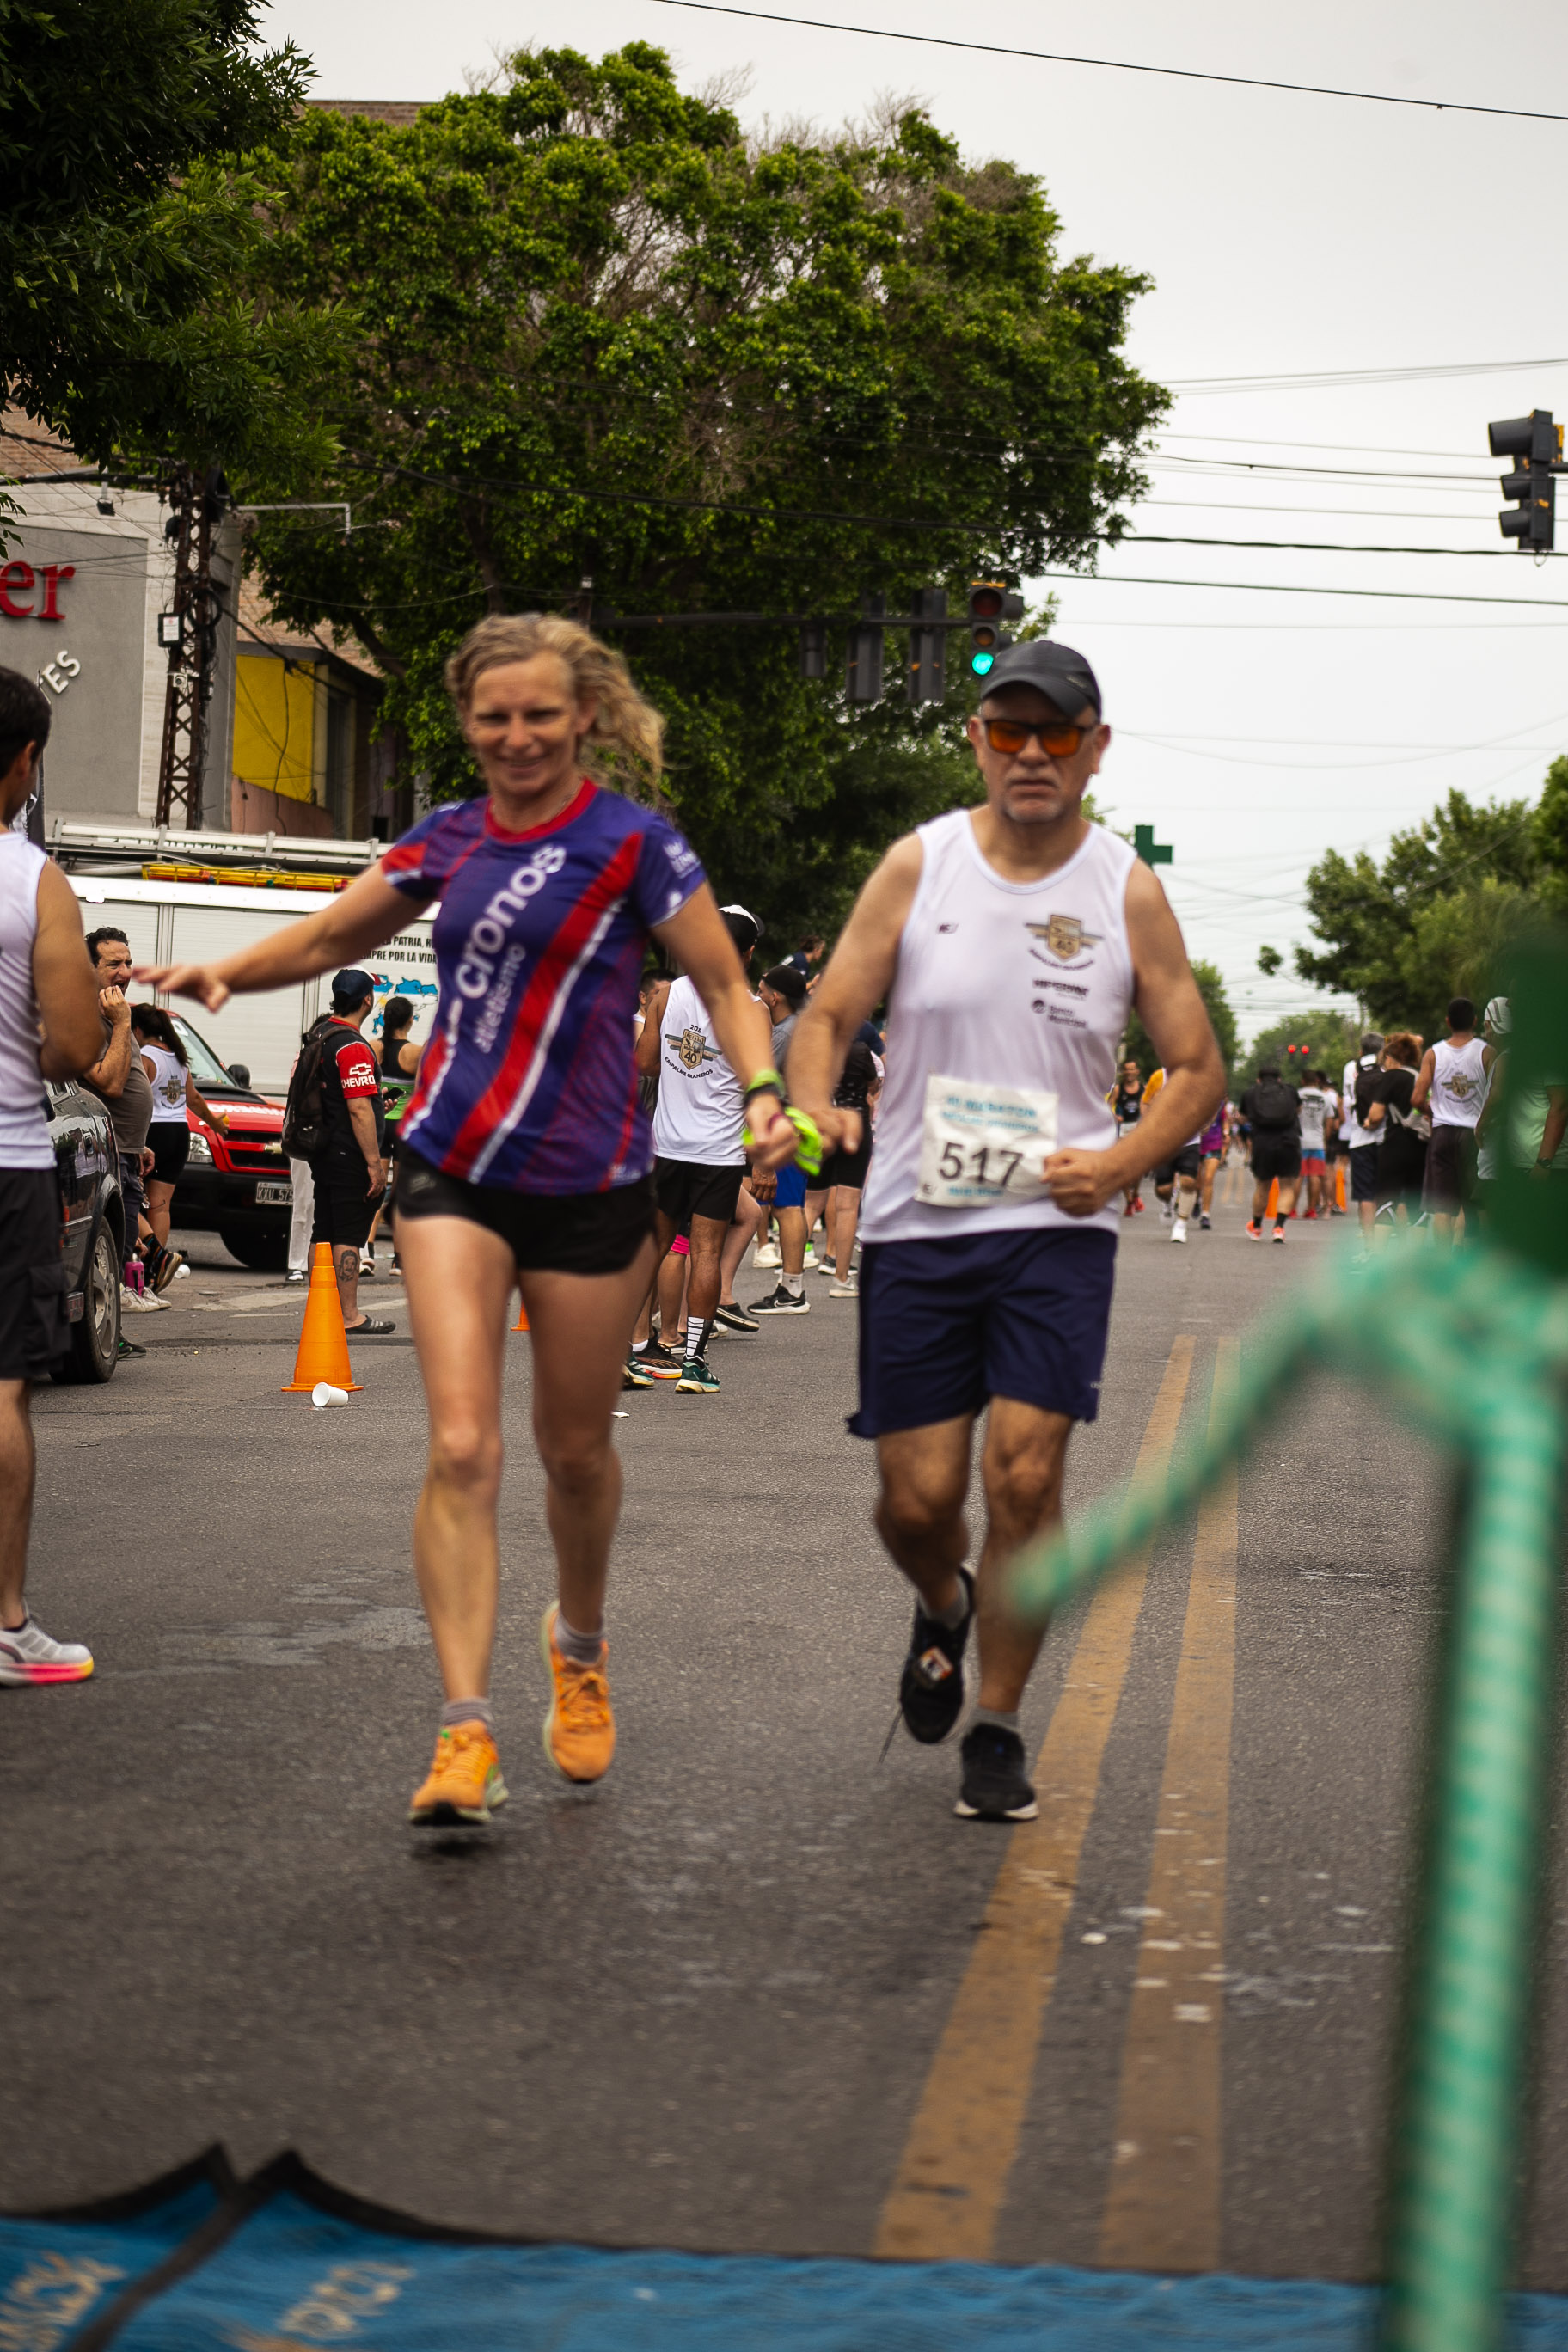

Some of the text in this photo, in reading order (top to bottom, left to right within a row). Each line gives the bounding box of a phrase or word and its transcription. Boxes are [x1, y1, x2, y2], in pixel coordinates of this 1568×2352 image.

[389, 951, 405, 961] POR
[407, 952, 417, 963] LA
[419, 952, 437, 964] VIDA
[684, 1051, 697, 1063] 40
[939, 1142, 1024, 1188] 517
